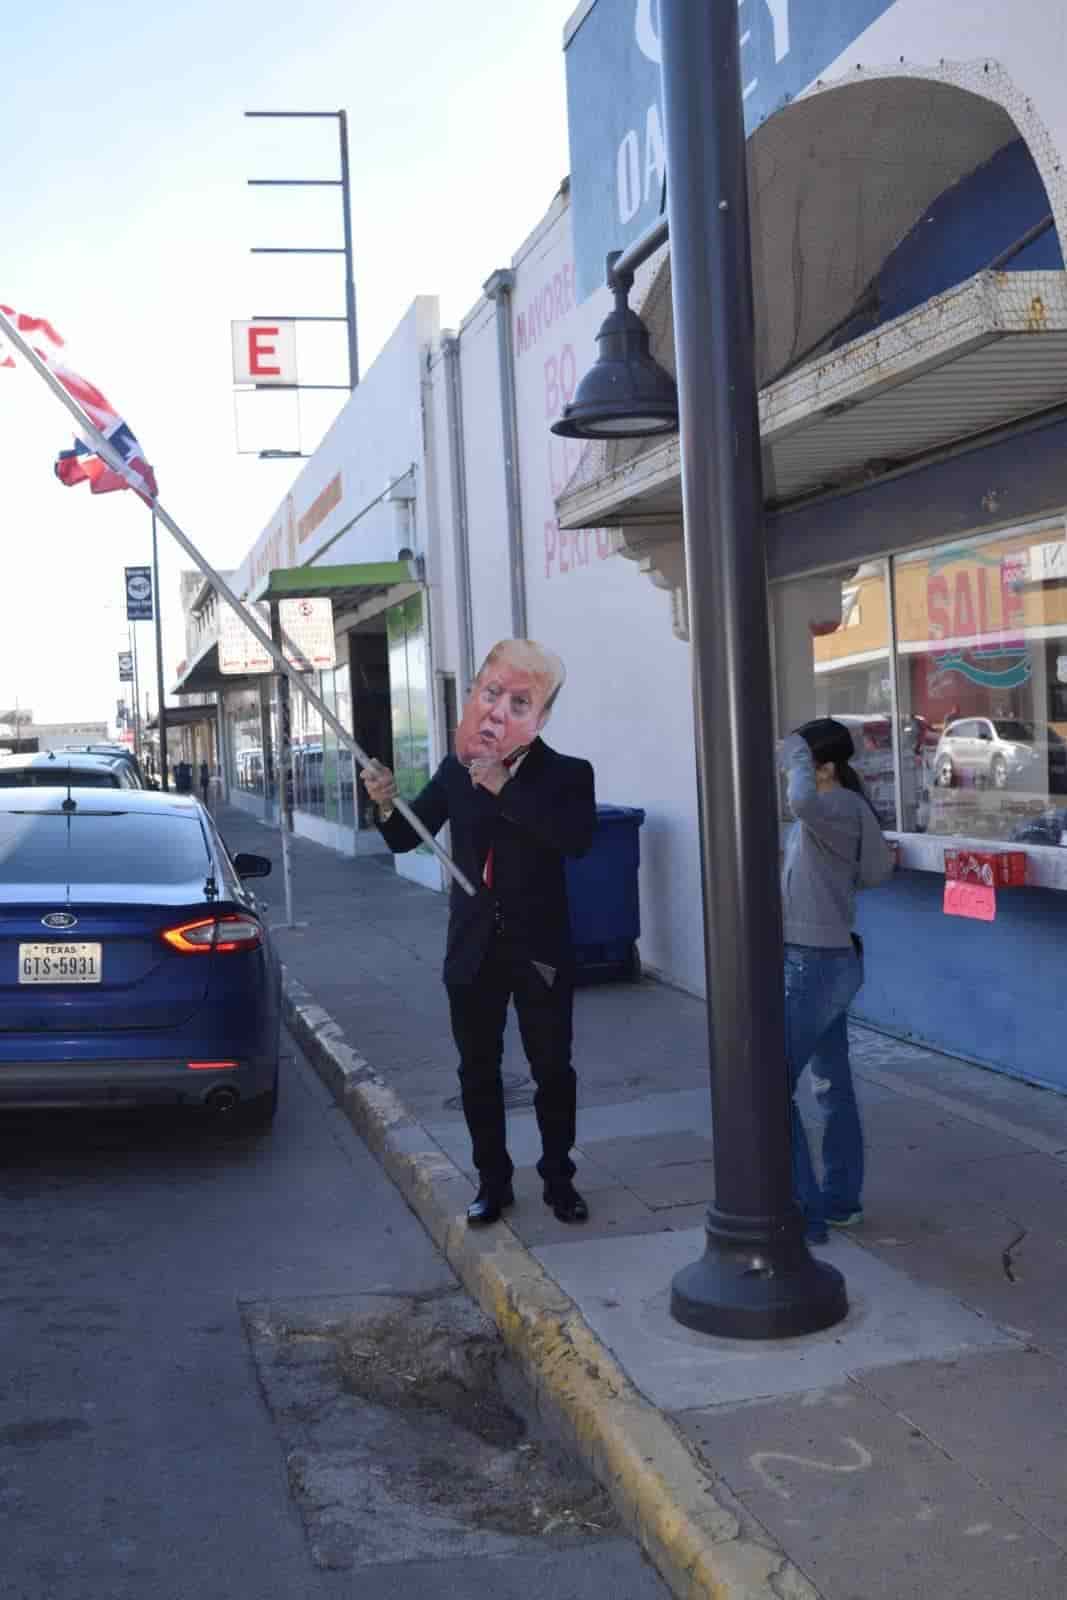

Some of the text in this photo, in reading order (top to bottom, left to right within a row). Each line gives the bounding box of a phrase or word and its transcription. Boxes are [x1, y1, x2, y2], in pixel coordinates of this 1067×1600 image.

[248, 327, 281, 376] E
[927, 562, 1025, 643] SALE
[45, 946, 77, 954] TEXAS
